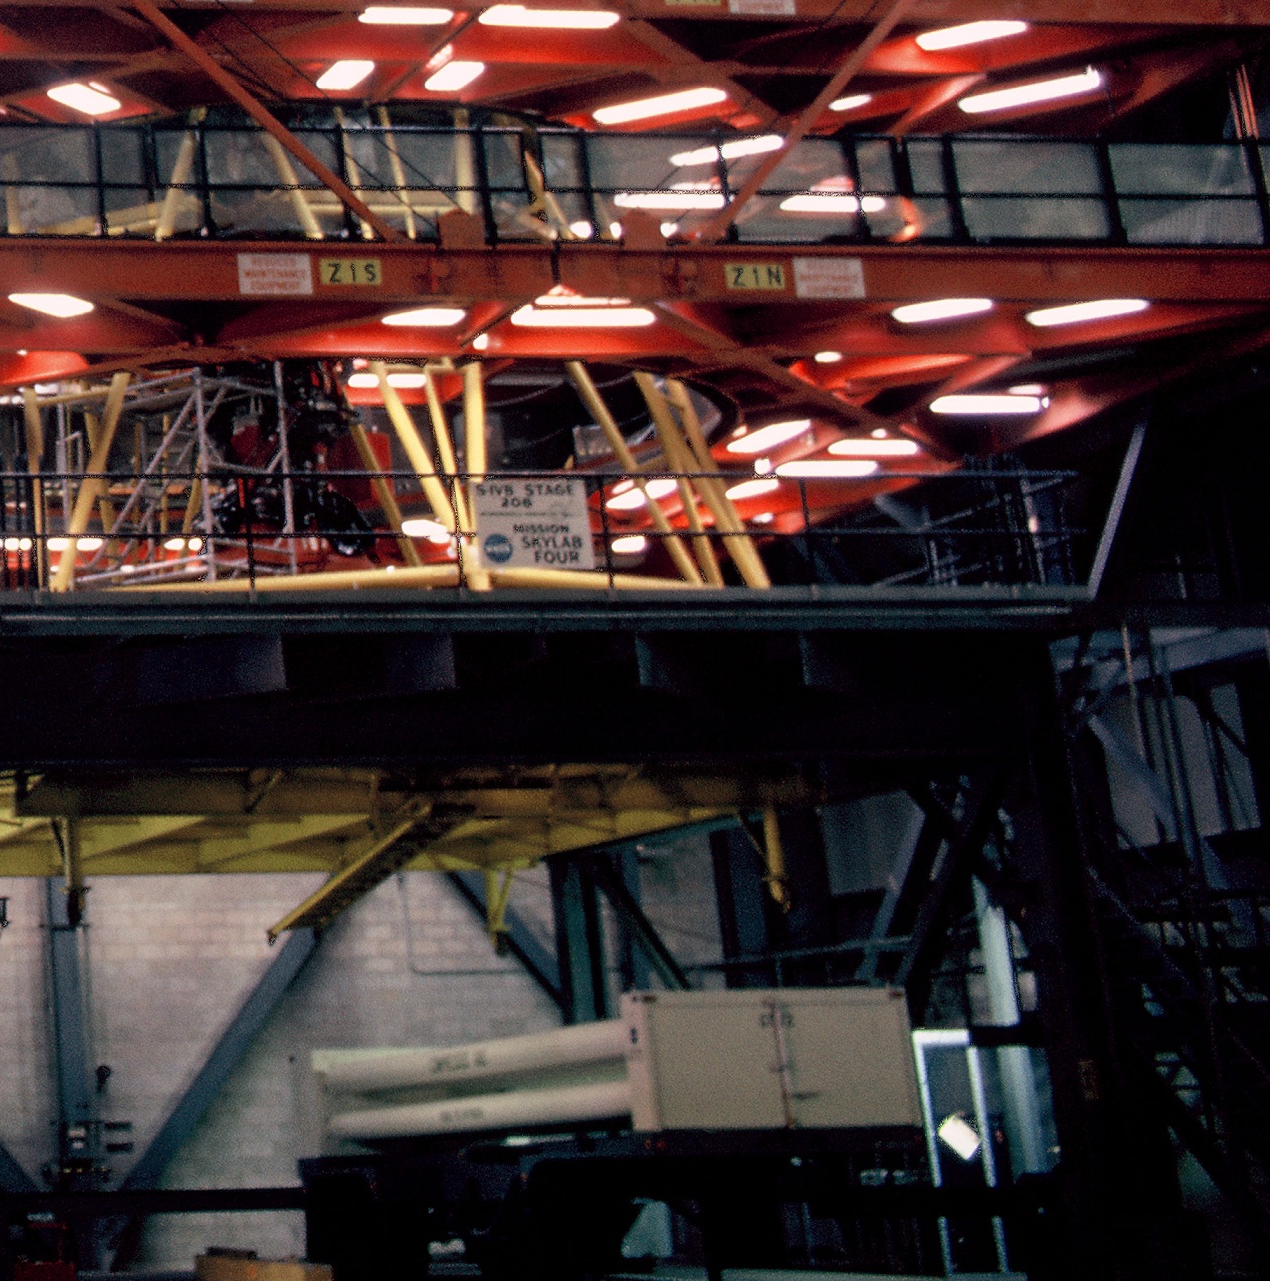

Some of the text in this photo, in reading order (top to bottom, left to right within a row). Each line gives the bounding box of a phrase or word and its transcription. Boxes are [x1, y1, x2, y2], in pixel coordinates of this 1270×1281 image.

[328, 263, 376, 283] Z1S
[733, 266, 782, 287] Z1N
[525, 483, 574, 496] STAGE
[513, 524, 570, 534] MISSION
[521, 536, 582, 549] SKYLAB
[535, 551, 580, 564] FOUR
